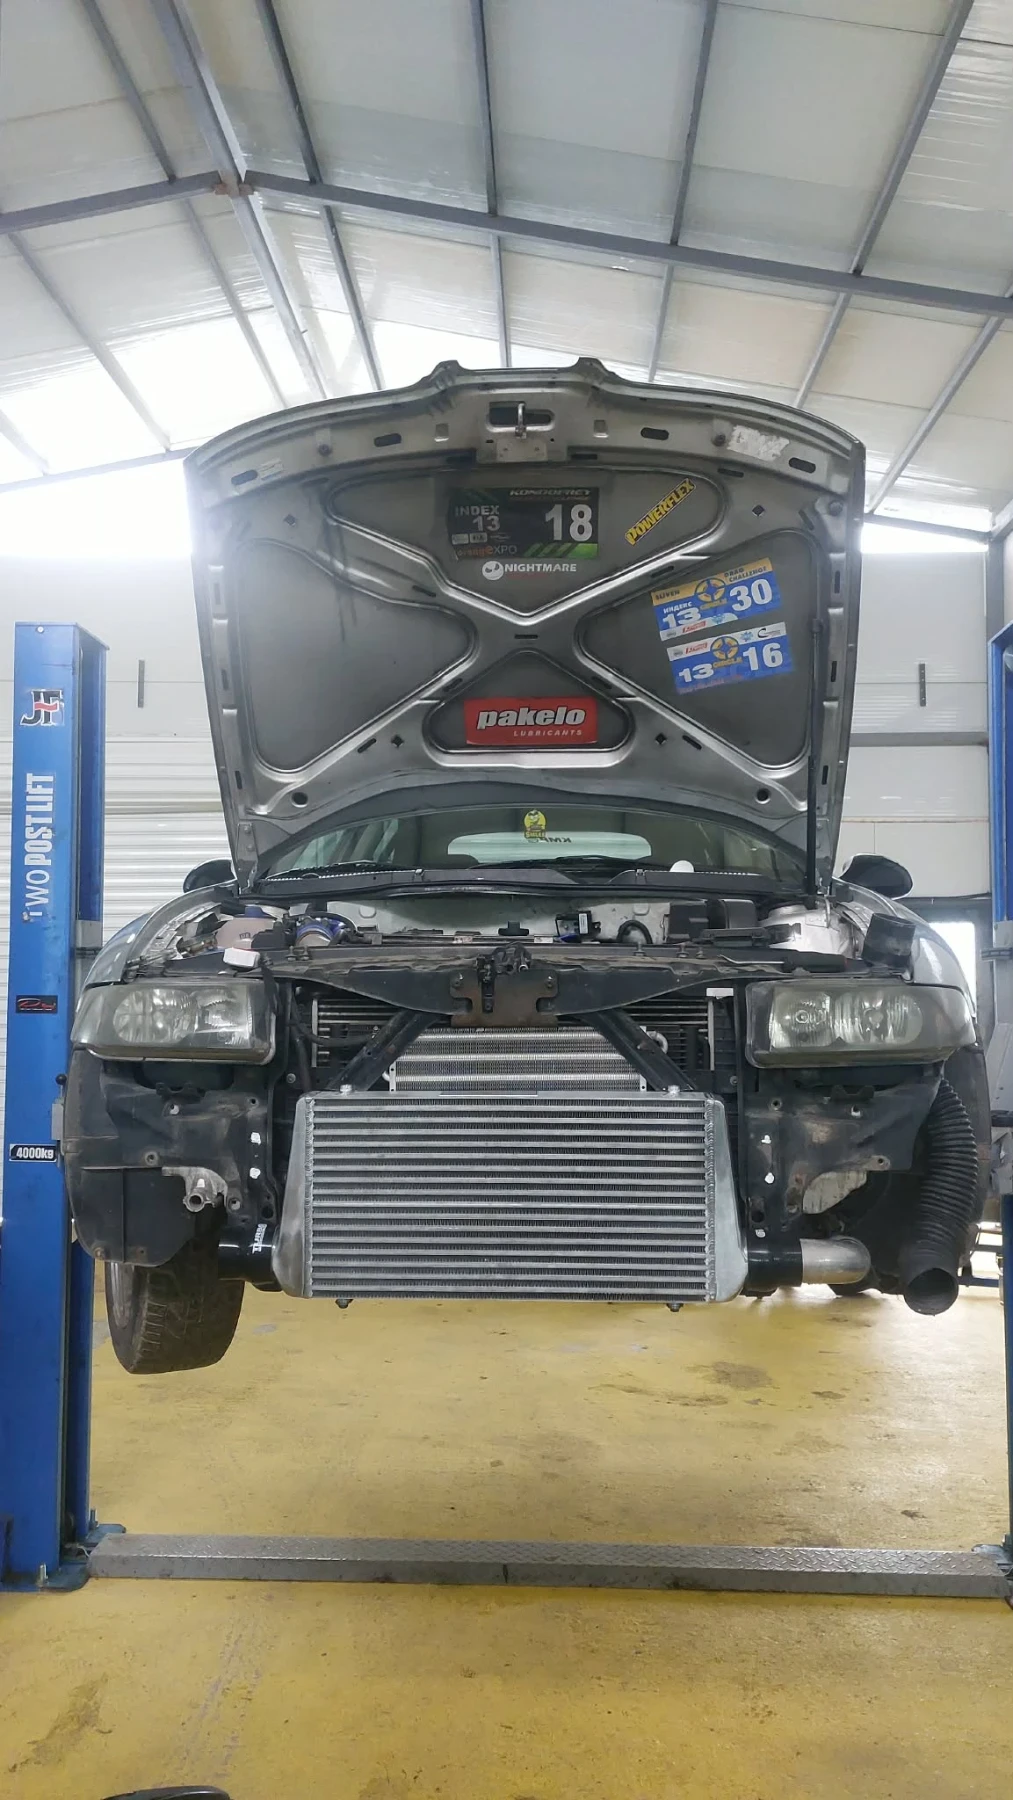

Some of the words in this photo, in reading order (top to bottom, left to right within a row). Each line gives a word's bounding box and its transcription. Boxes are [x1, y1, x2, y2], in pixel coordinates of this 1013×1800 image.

[455, 505, 500, 516] INDEX
[545, 503, 593, 542] 18
[626, 478, 695, 545] POWERFLEX
[472, 515, 501, 532] 13
[504, 563, 578, 573] NIGHTMARE
[729, 578, 773, 612] 30
[662, 606, 701, 628] 13
[742, 642, 783, 671] 16
[678, 663, 714, 683] 13
[476, 705, 587, 731] pakelo
[513, 729, 582, 737] LUBRICANTS
[26, 772, 54, 812] LIFT
[24, 814, 53, 866] POST
[16, 1147, 54, 1159] 4000kg
